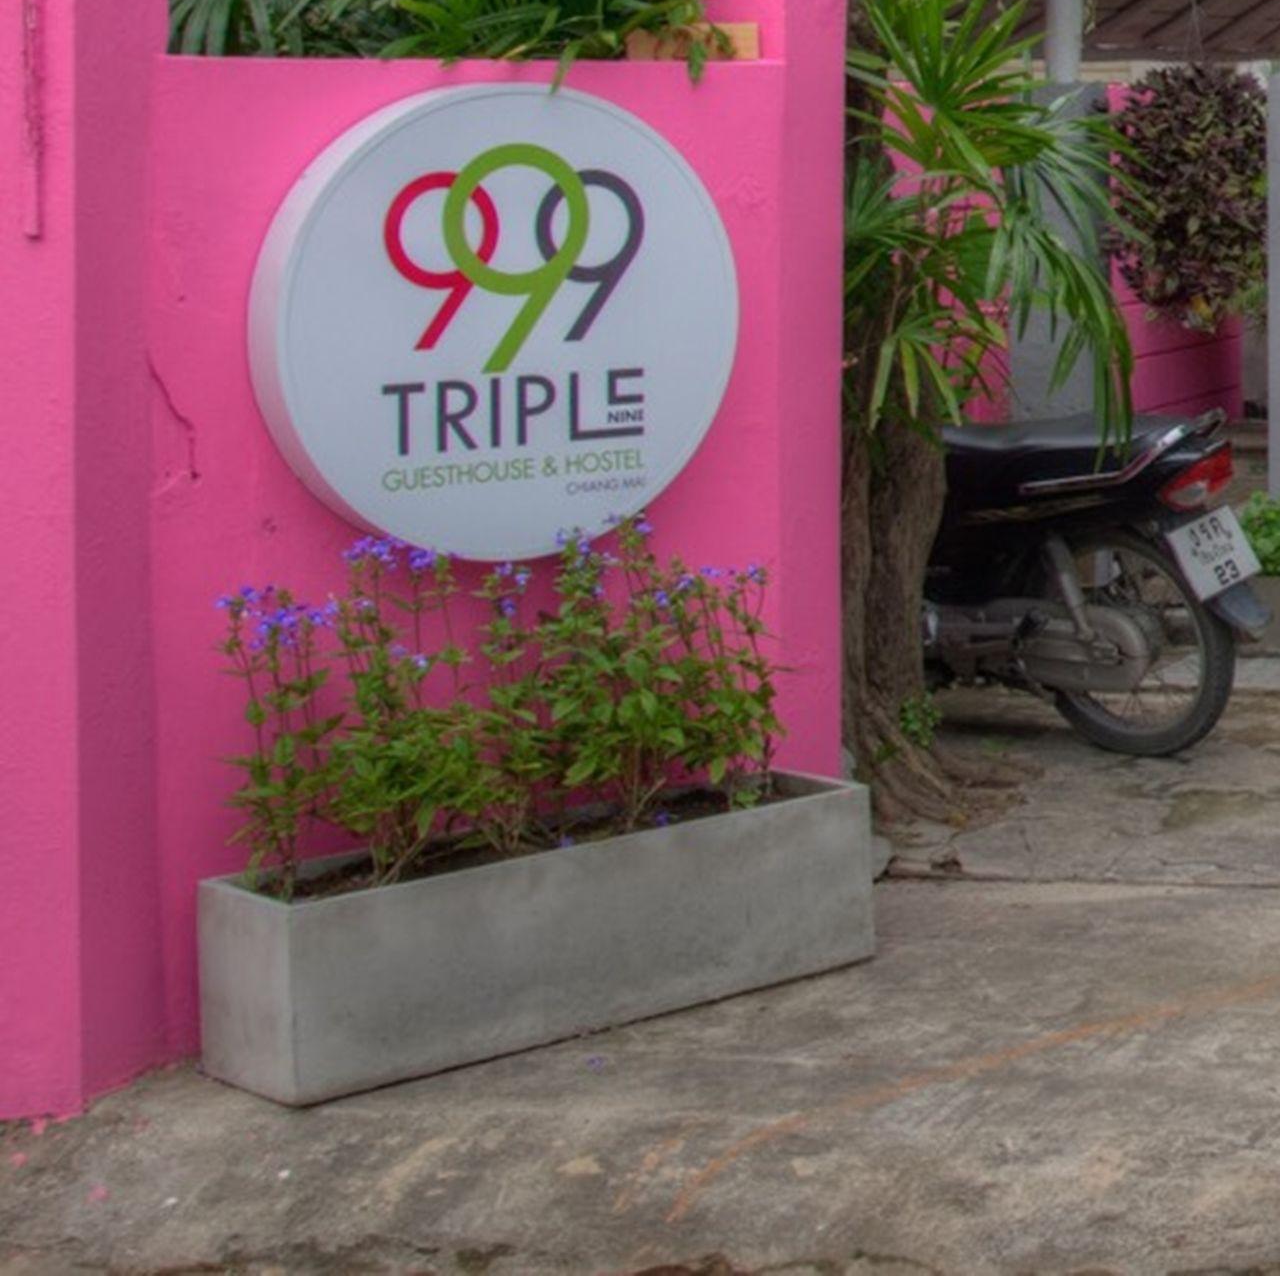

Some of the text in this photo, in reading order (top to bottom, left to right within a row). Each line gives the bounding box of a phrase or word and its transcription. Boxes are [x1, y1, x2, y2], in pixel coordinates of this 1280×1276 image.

[383, 142, 645, 374] 999
[381, 367, 645, 456] TRIPLE
[607, 410, 644, 423] NINE
[381, 449, 643, 493] GUESTHOUSE & HOSTEL
[566, 479, 618, 495] CHIANG
